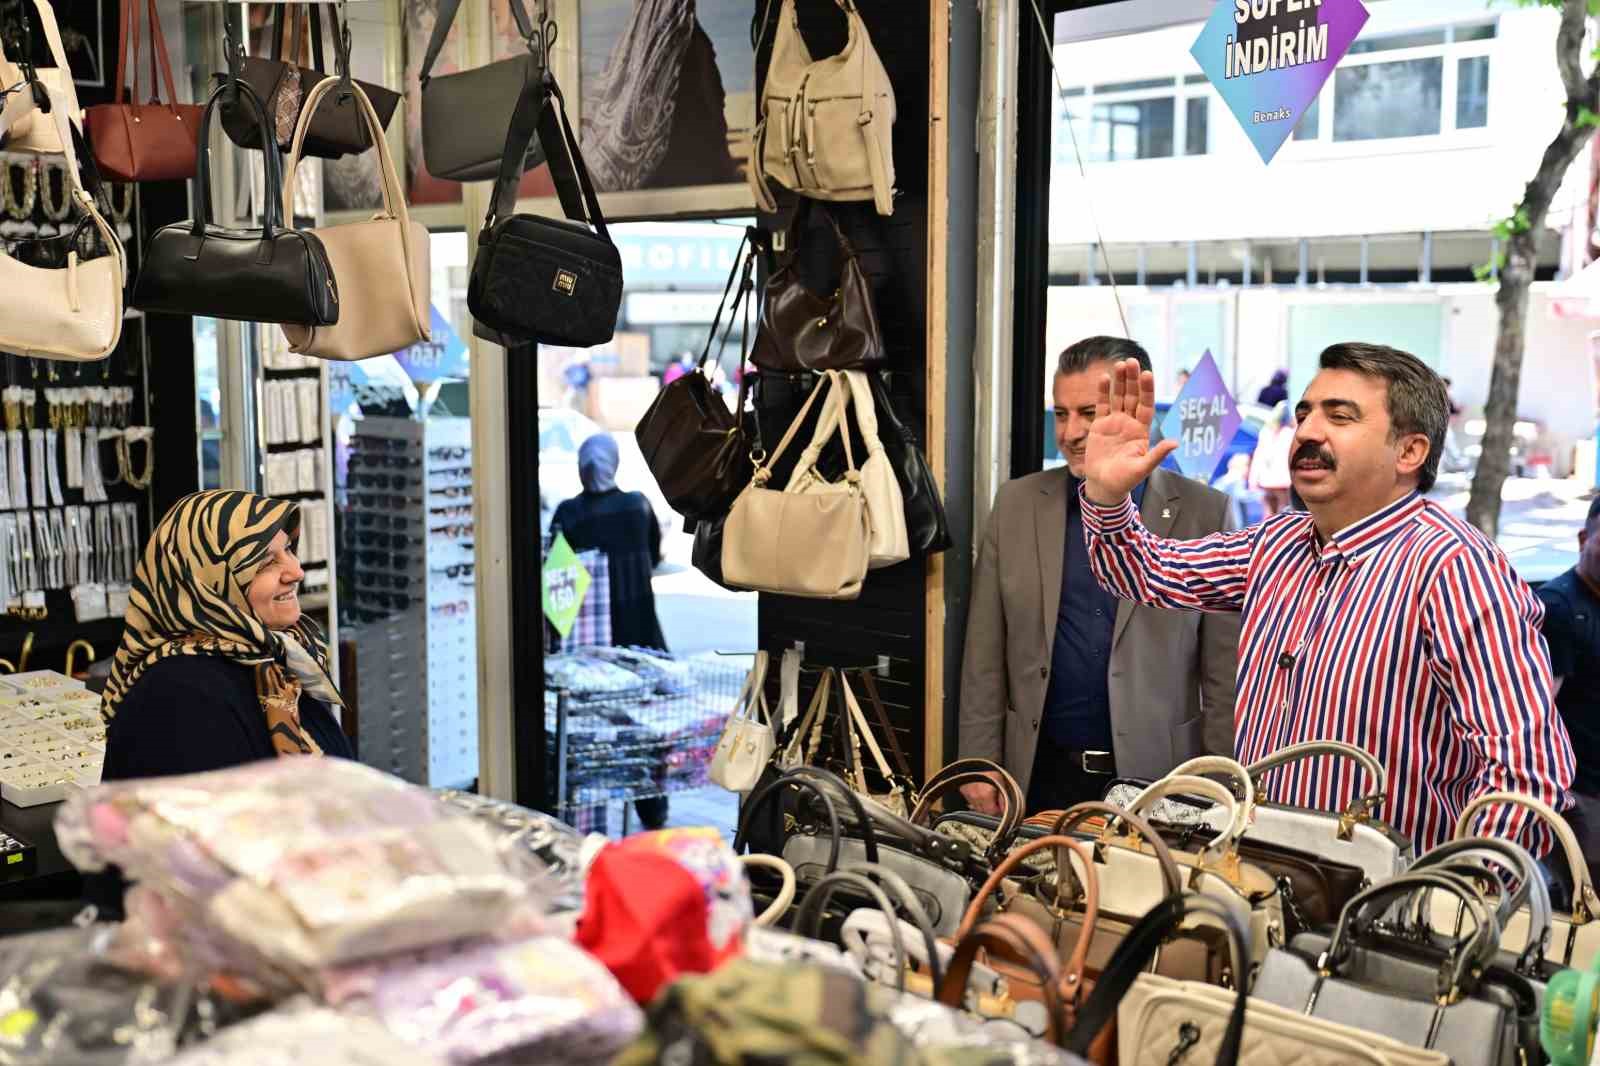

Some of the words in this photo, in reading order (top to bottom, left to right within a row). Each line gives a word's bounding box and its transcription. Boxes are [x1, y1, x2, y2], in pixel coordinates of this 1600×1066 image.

[1224, 20, 1328, 79] İNDİRİM
[1253, 107, 1292, 124] Benaks
[1210, 394, 1228, 416] AL
